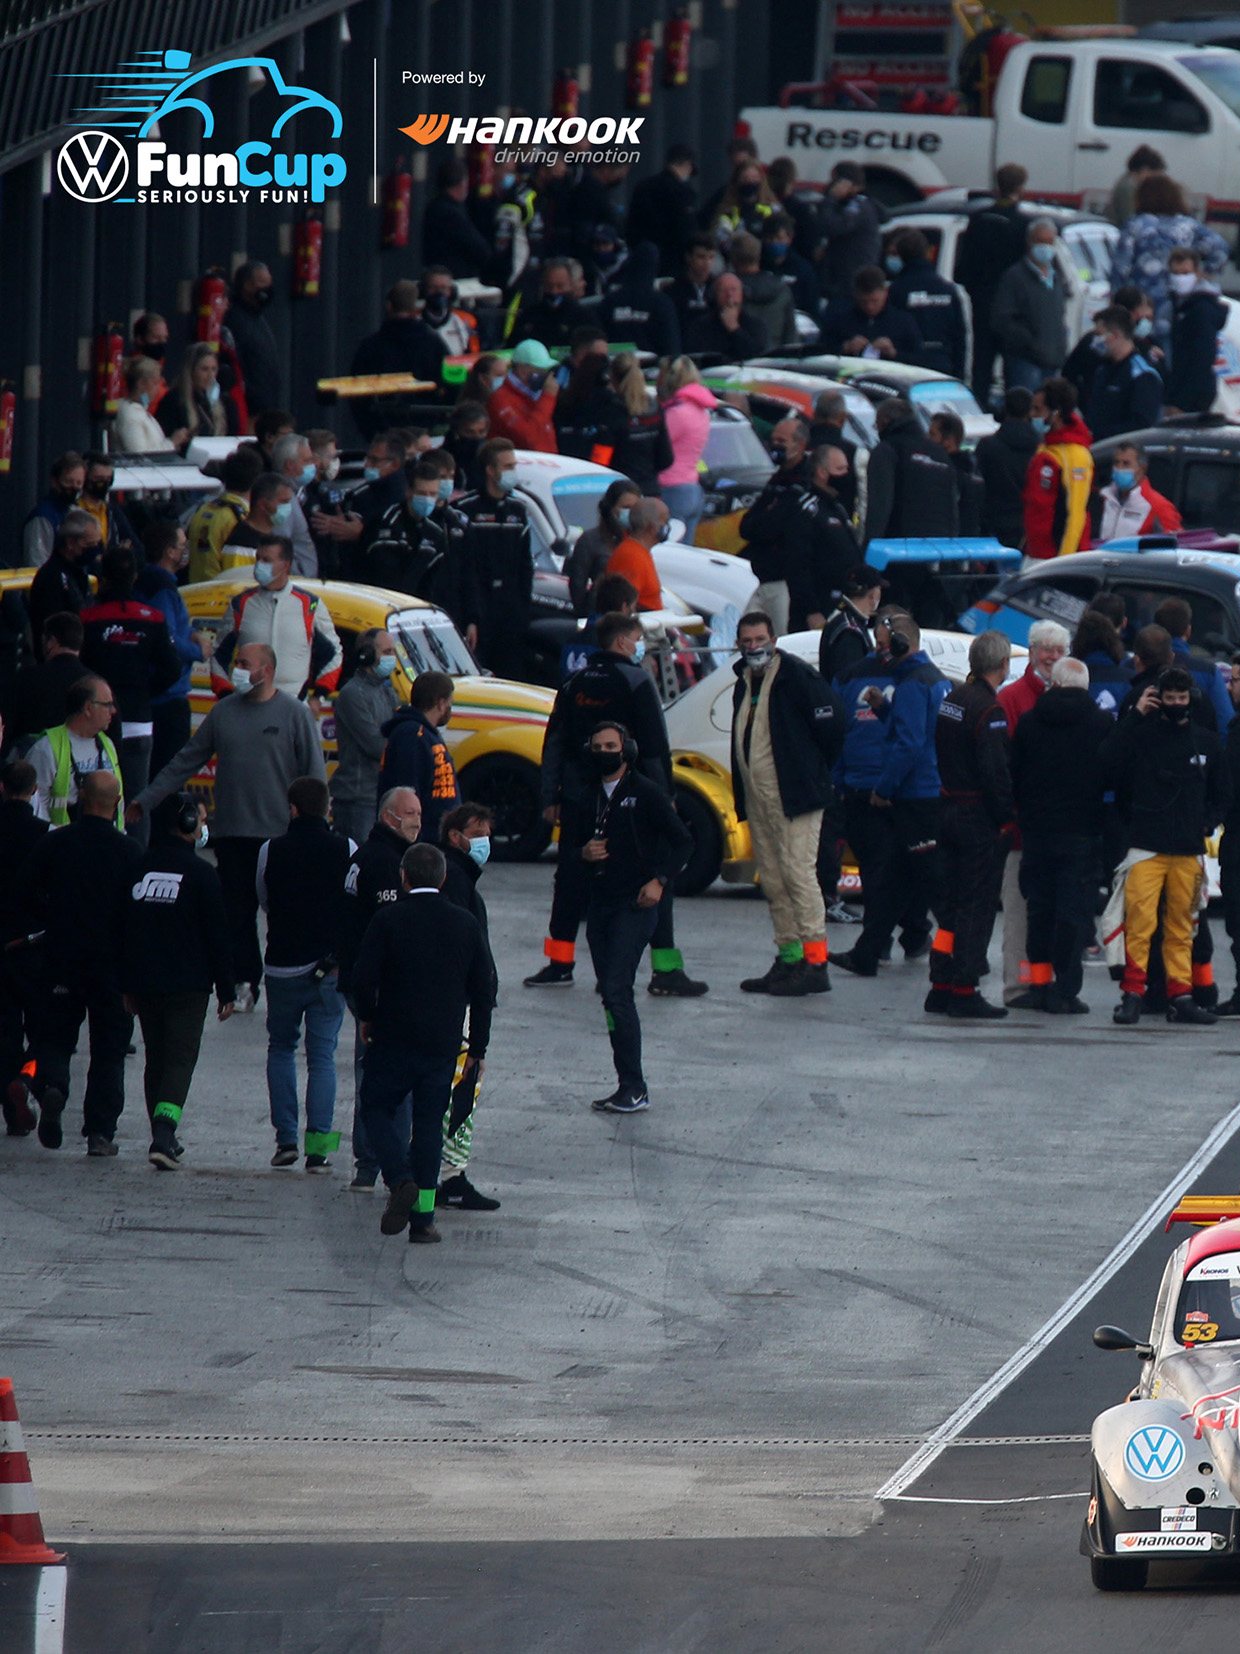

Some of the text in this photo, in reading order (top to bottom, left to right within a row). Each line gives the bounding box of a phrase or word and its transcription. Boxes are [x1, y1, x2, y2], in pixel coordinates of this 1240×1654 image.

[787, 122, 943, 153] Rescue
[376, 889, 398, 903] 365
[1182, 1322, 1219, 1342] 53
[1162, 1515, 1196, 1523] CREDECO
